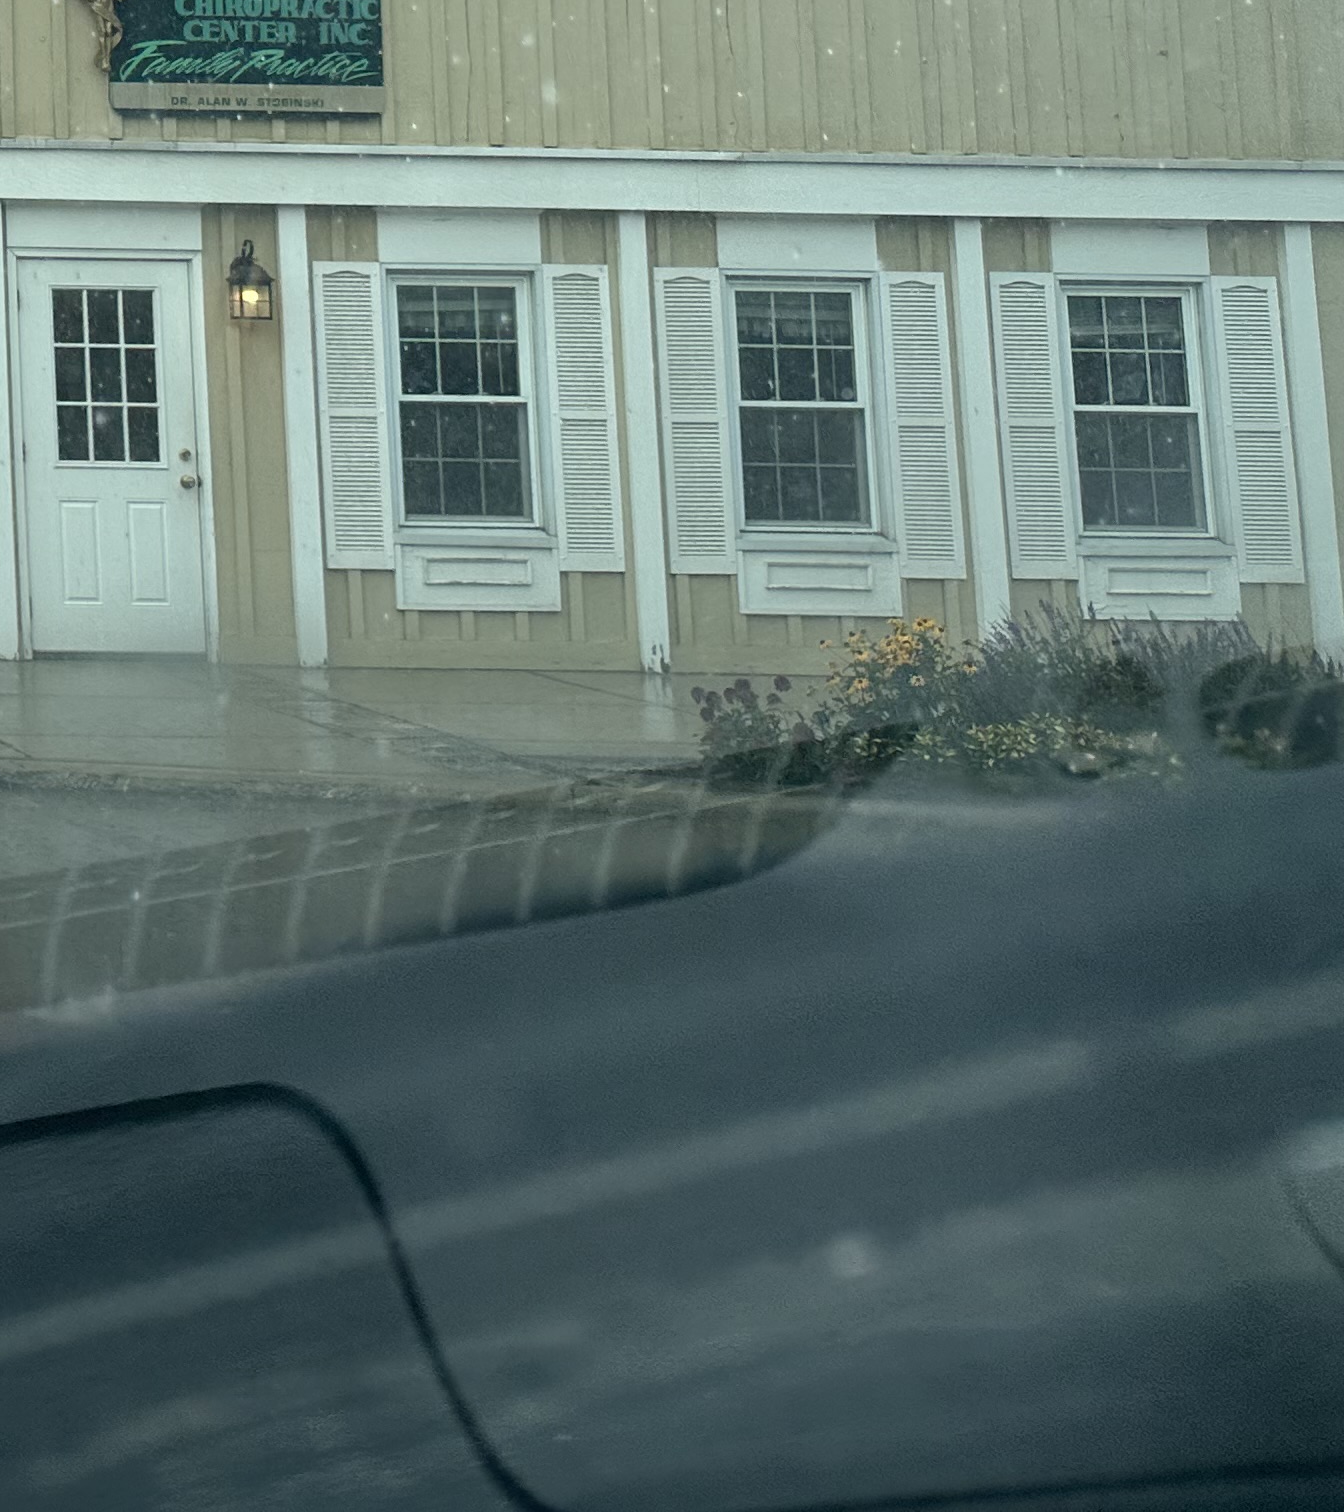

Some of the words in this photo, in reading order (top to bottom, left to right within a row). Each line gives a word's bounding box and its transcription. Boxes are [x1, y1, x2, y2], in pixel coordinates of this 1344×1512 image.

[119, 40, 244, 82] Family
[230, 49, 379, 83] Practice
[197, 97, 231, 107] ALAN
